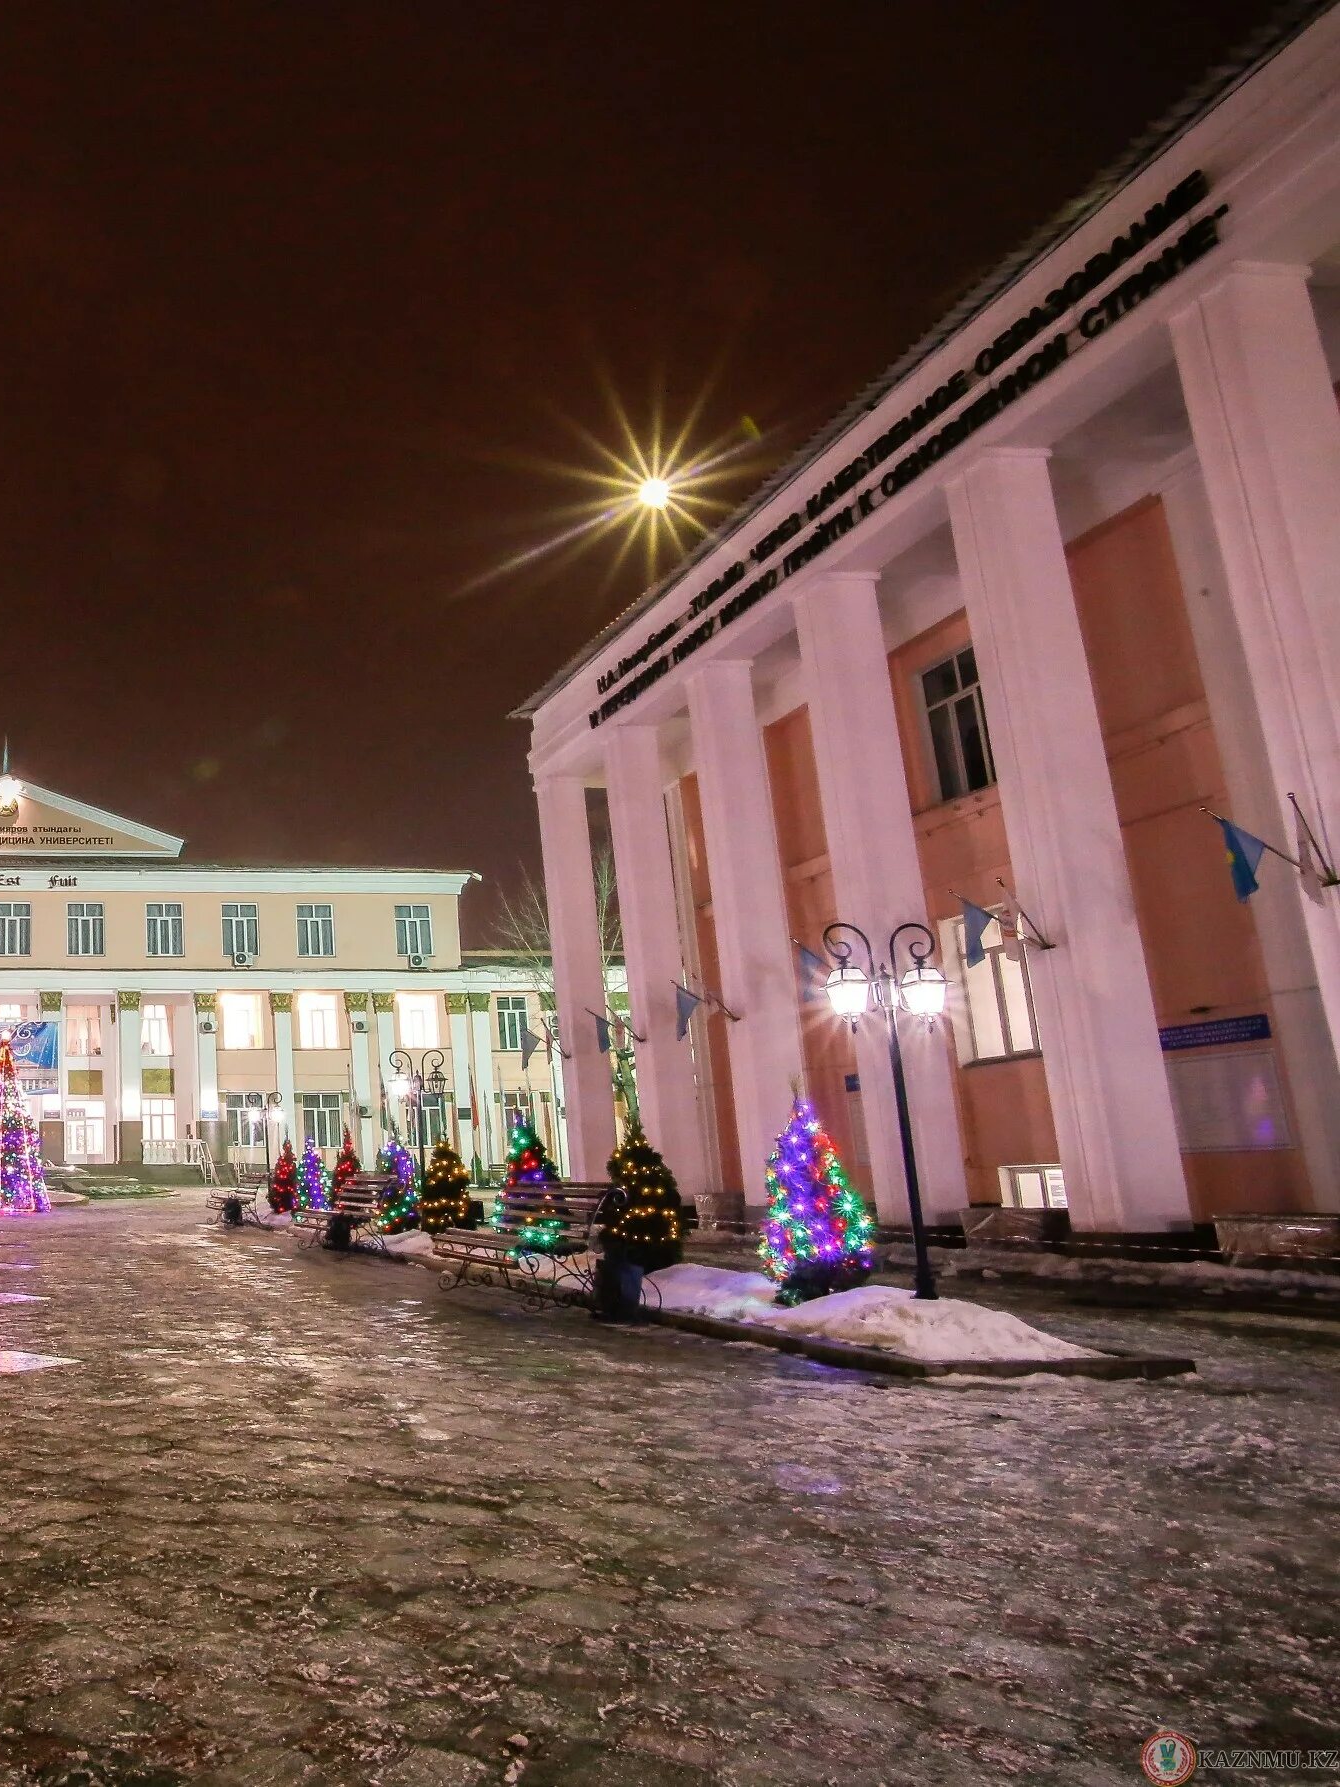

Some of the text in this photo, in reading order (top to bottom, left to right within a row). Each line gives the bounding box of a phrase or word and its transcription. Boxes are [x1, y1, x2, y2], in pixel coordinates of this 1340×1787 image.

[749, 512, 801, 563] ЧЕРЕЗ
[806, 369, 968, 522] КАЧЕСТВЕННОЕ
[974, 169, 1209, 376] ОБРАЗОВАНИЕ
[782, 506, 854, 578] ПРИЙТИ
[858, 488, 874, 517] К
[39, 836, 113, 845] УНИВЕРСИТЕТІ
[47, 875, 78, 889] Fuit
